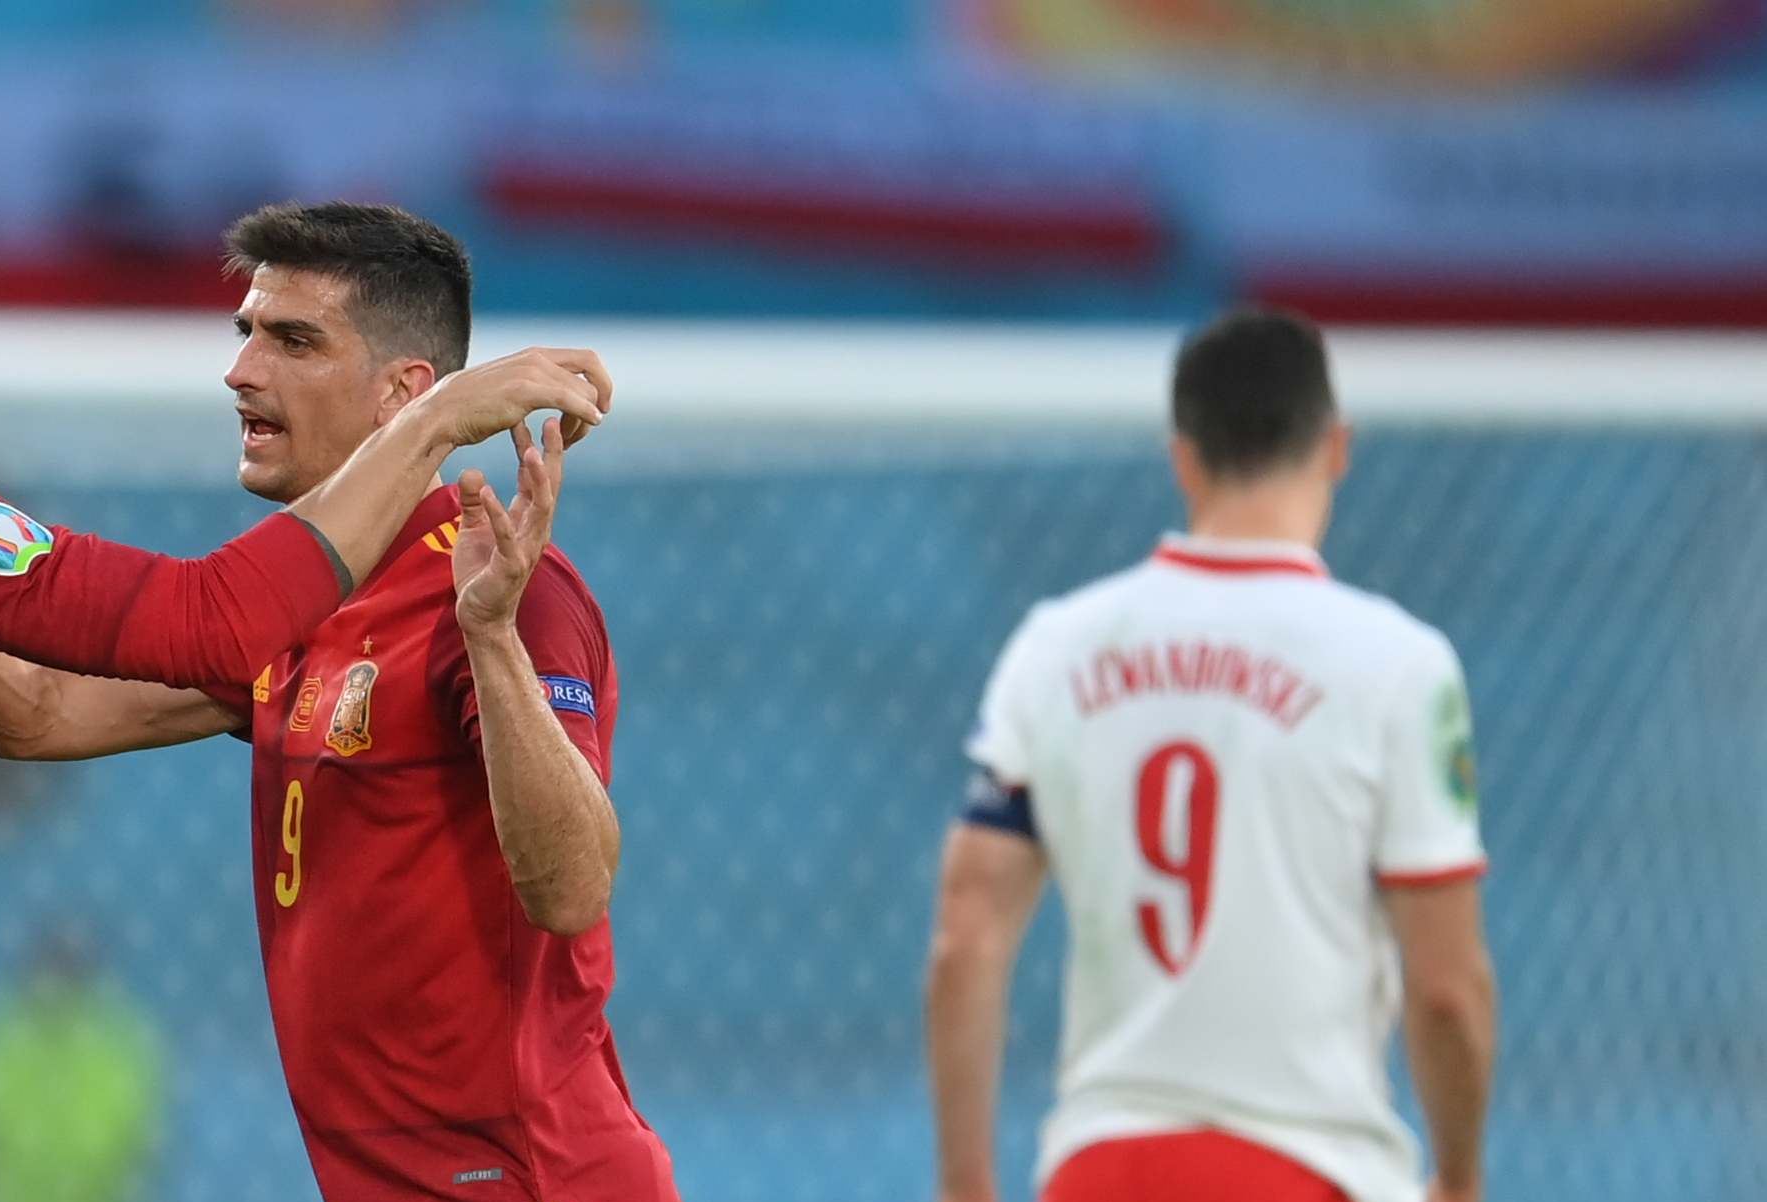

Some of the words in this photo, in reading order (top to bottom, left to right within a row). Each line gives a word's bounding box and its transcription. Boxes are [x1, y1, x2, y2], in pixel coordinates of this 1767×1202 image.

[553, 685, 595, 712] RESP
[275, 780, 304, 908] 9
[1135, 738, 1220, 977] 9
